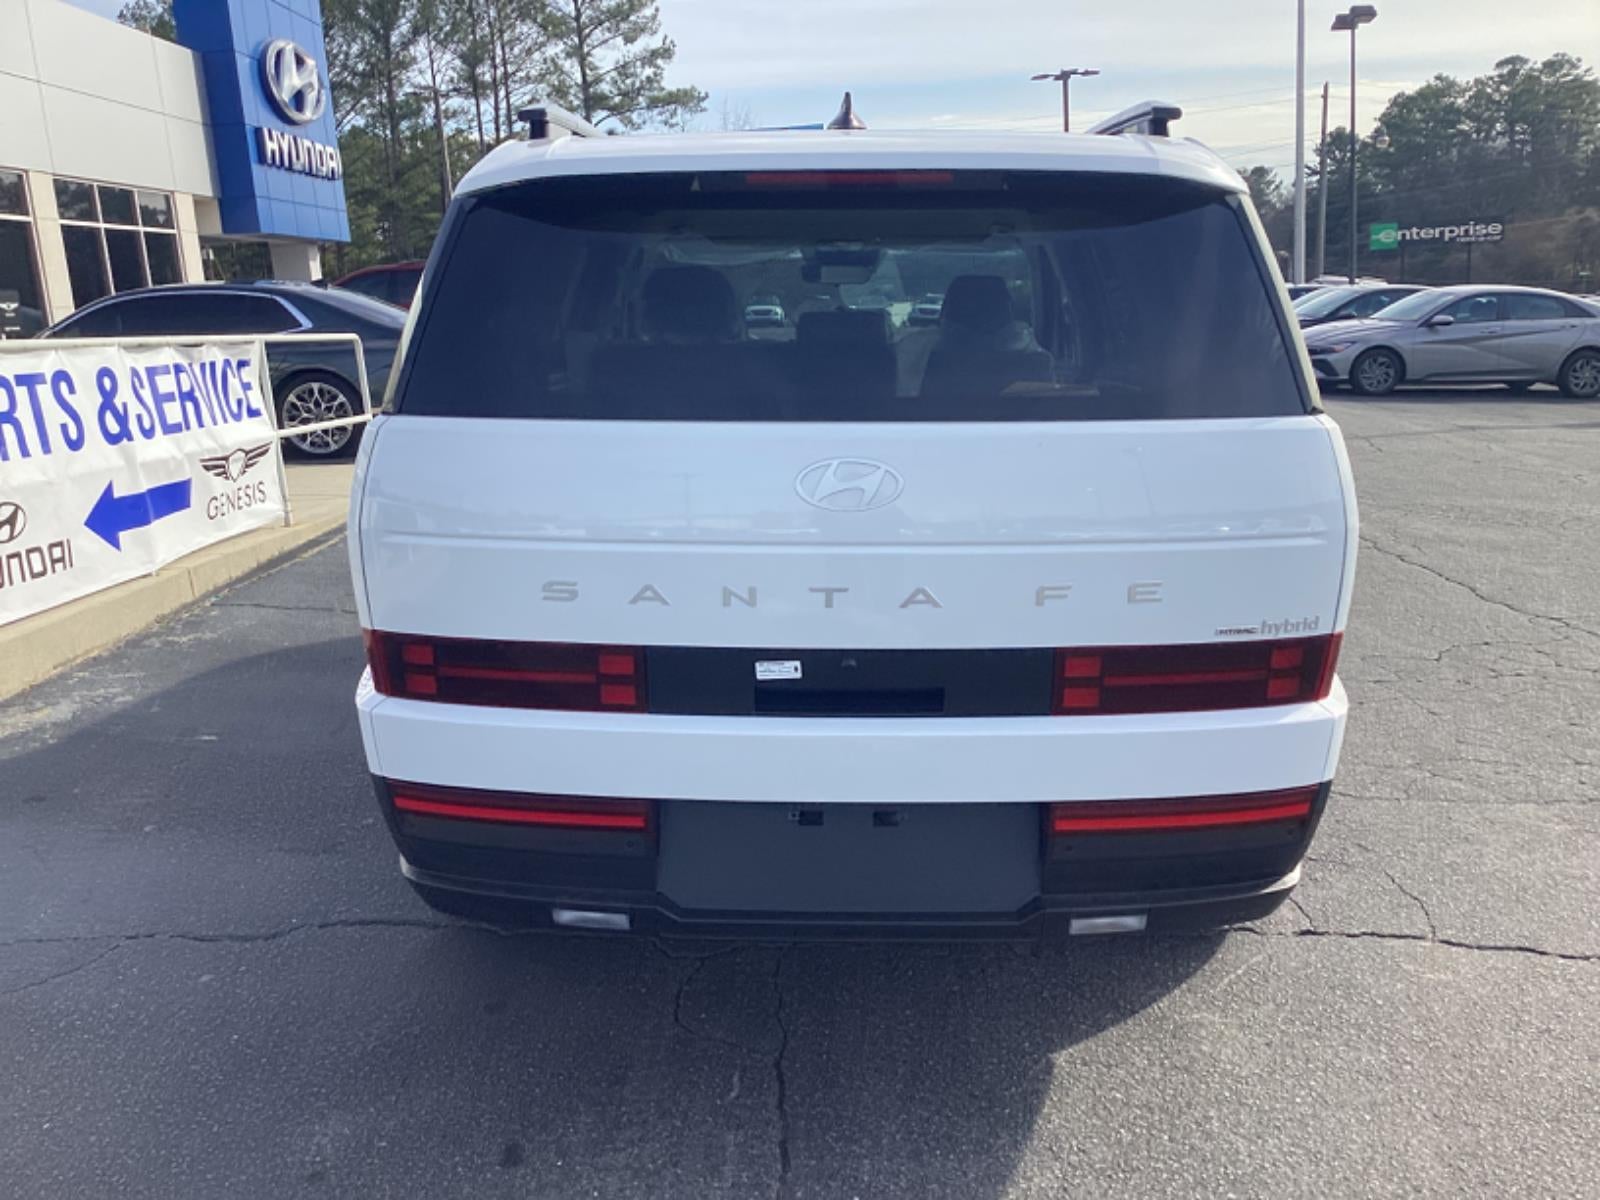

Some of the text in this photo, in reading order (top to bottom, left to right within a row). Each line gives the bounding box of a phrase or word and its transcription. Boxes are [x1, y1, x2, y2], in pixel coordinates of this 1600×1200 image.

[262, 127, 342, 180] HYUNDAI
[1372, 221, 1503, 242] enterprise
[96, 366, 134, 446] &
[130, 358, 262, 440] SERVICE
[207, 481, 267, 520] GENESIS
[0, 538, 74, 589] NDAI
[541, 579, 1165, 609] SANTA FE
[1260, 615, 1320, 635] hybrid
